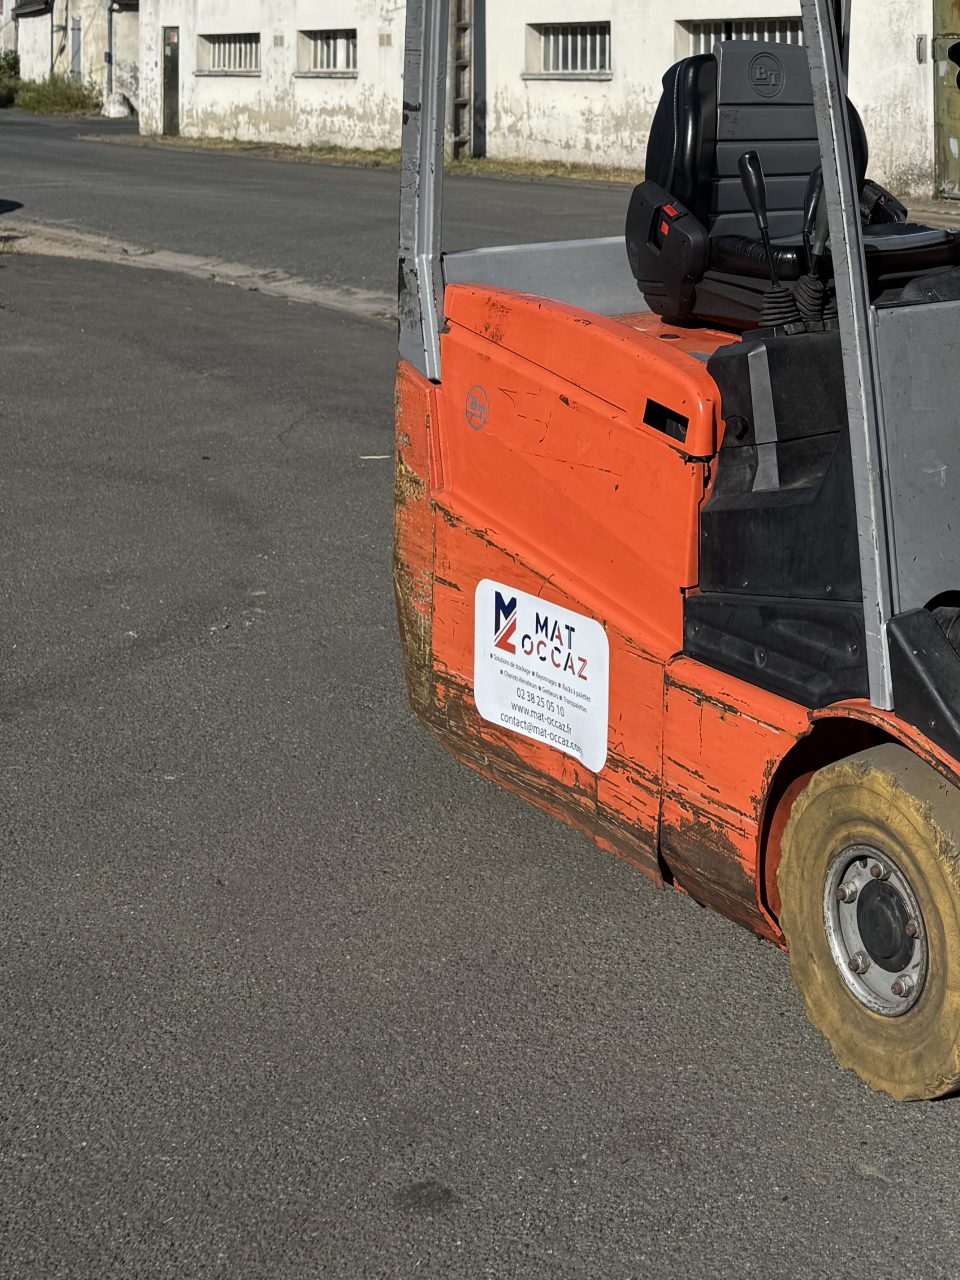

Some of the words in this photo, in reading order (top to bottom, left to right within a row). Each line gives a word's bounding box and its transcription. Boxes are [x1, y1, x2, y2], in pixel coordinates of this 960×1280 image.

[752, 64, 779, 86] BT
[535, 611, 575, 650] MAT
[521, 633, 588, 681] OCCAZ
[511, 700, 572, 735] www.mat-occaz.fr
[516, 687, 525, 700] 02
[526, 691, 535, 704] 38
[536, 695, 545, 708] 25
[546, 700, 555, 712] 05
[556, 704, 565, 717] 10
